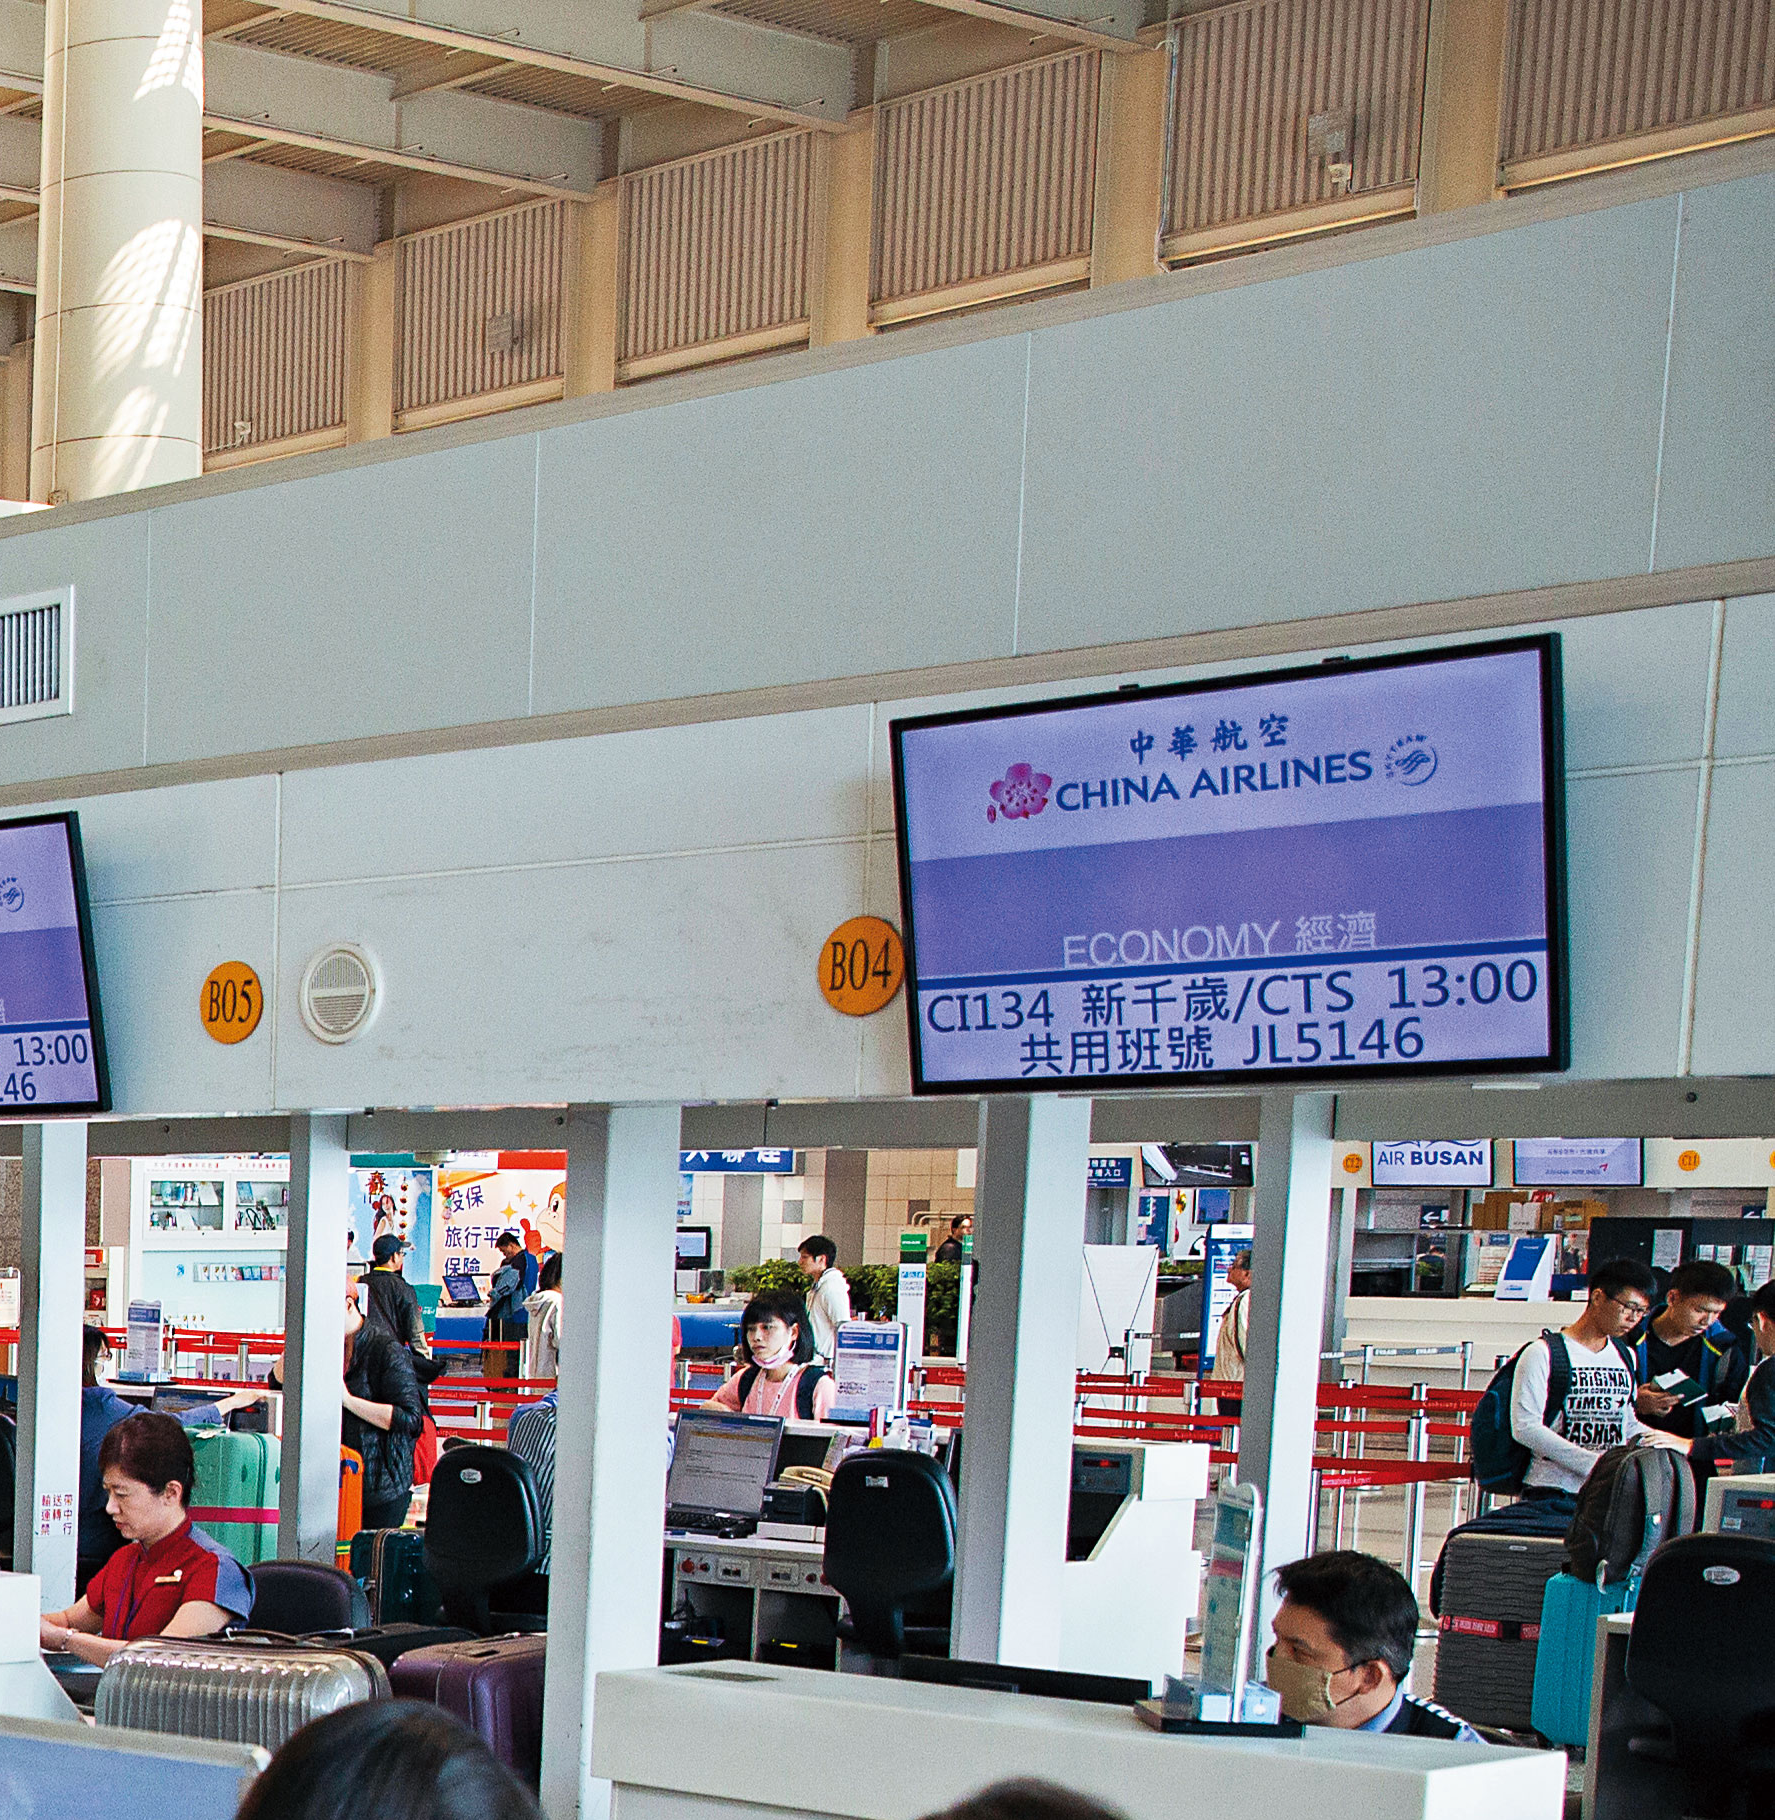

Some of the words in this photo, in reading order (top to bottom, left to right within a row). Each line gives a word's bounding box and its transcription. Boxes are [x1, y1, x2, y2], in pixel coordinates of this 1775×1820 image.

[1130, 712, 1289, 763] 中華航空
[1056, 766, 1180, 812] CHINA
[1190, 751, 1372, 798] AIRLINES
[829, 938, 893, 991] B04
[1063, 922, 1280, 969] ECONOMY
[1295, 912, 1376, 952] 經濟
[208, 979, 253, 1023] B05
[927, 989, 1054, 1034] CI134
[1082, 971, 1354, 1028] 新千歲/CTS
[1389, 960, 1538, 1010] 13:00
[15, 1034, 87, 1066] 13:00
[1020, 1025, 1214, 1077] 共用班號
[1243, 1017, 1423, 1066] JL5146
[1378, 1151, 1404, 1165] AIR
[1410, 1151, 1483, 1165] BUSAN
